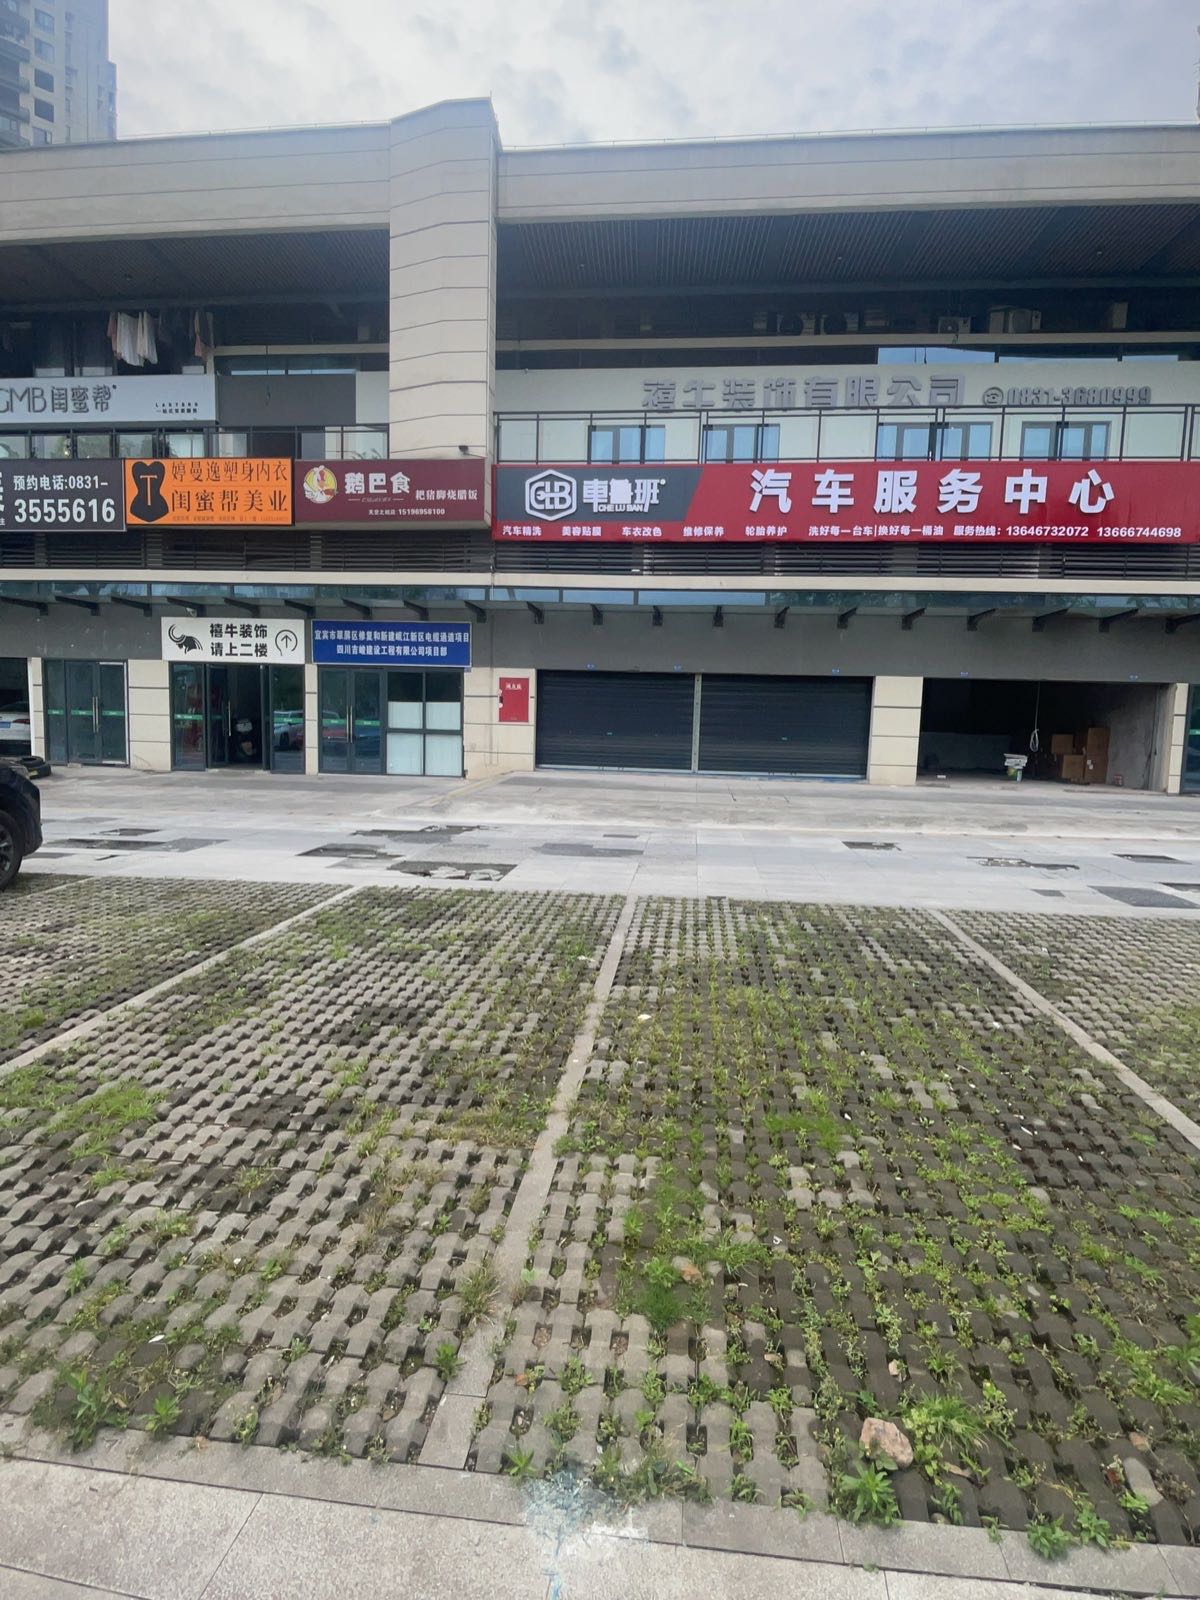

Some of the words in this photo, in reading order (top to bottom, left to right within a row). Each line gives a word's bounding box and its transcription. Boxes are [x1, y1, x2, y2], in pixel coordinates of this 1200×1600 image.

[13, 474, 109, 491] 预约电话:0831-
[172, 461, 288, 483] 婷曼逸塑身内衣
[345, 471, 411, 495] 鹅巴食
[172, 490, 288, 513] 闺蜜帮美业
[749, 468, 1115, 515] 汽车服务中心
[14, 498, 116, 523] 3555616
[502, 525, 542, 537] 汽车精洗
[562, 525, 602, 537] 美容贴膜
[622, 526, 662, 537] 车衣改色
[683, 526, 724, 537] 维修保养
[745, 525, 787, 537] 轮胎养护
[1005, 526, 1089, 537] 13646732072
[1096, 526, 1182, 538] 13666744698
[209, 623, 268, 638] 禧牛装饰
[210, 642, 268, 658] 请上二楼
